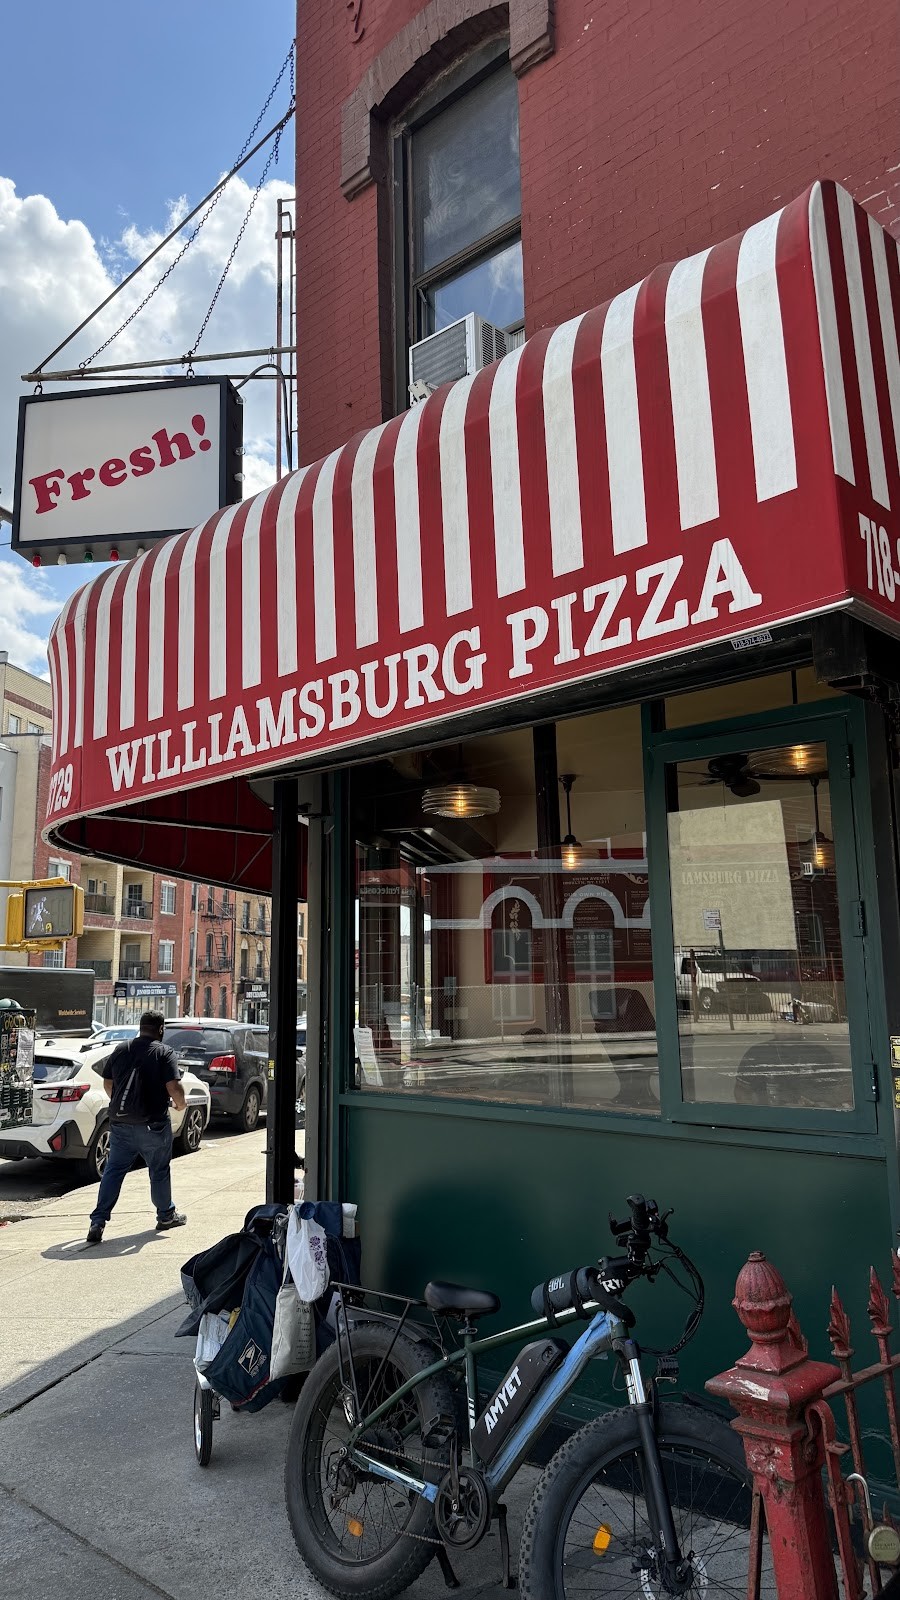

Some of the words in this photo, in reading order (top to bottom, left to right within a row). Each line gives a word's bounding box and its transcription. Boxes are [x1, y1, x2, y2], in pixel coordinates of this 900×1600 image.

[28, 414, 212, 515] Fresh!
[858, 511, 900, 602] 718-
[105, 627, 488, 793] WILLIAMSBURG
[506, 537, 763, 680] PIZZA
[745, 869, 780, 884] PIZZA
[548, 1278, 565, 1293] JBL
[484, 1365, 522, 1435] AMYET
